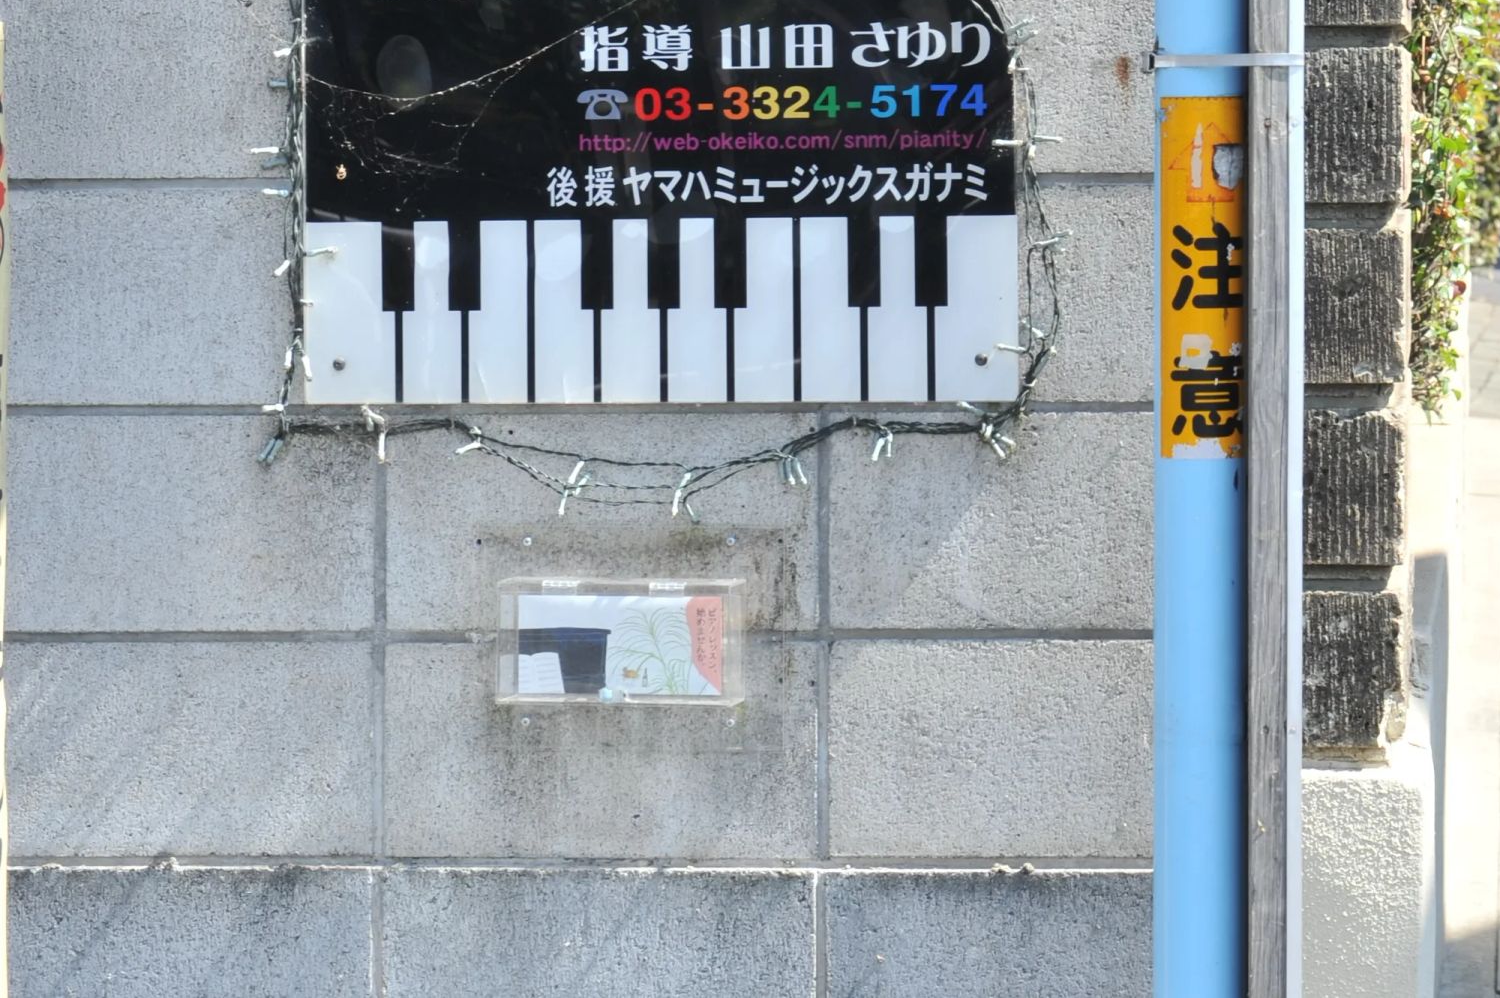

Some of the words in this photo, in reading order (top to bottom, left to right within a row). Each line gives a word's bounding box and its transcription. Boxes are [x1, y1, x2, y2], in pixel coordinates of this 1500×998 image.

[635, 84, 988, 121] 03-3324-5174
[578, 130, 988, 156] http://web-okeiko.com/snm/pianity/
[623, 162, 988, 205] ヤマハミュージックスガナミ
[1170, 222, 1245, 438] 注意
